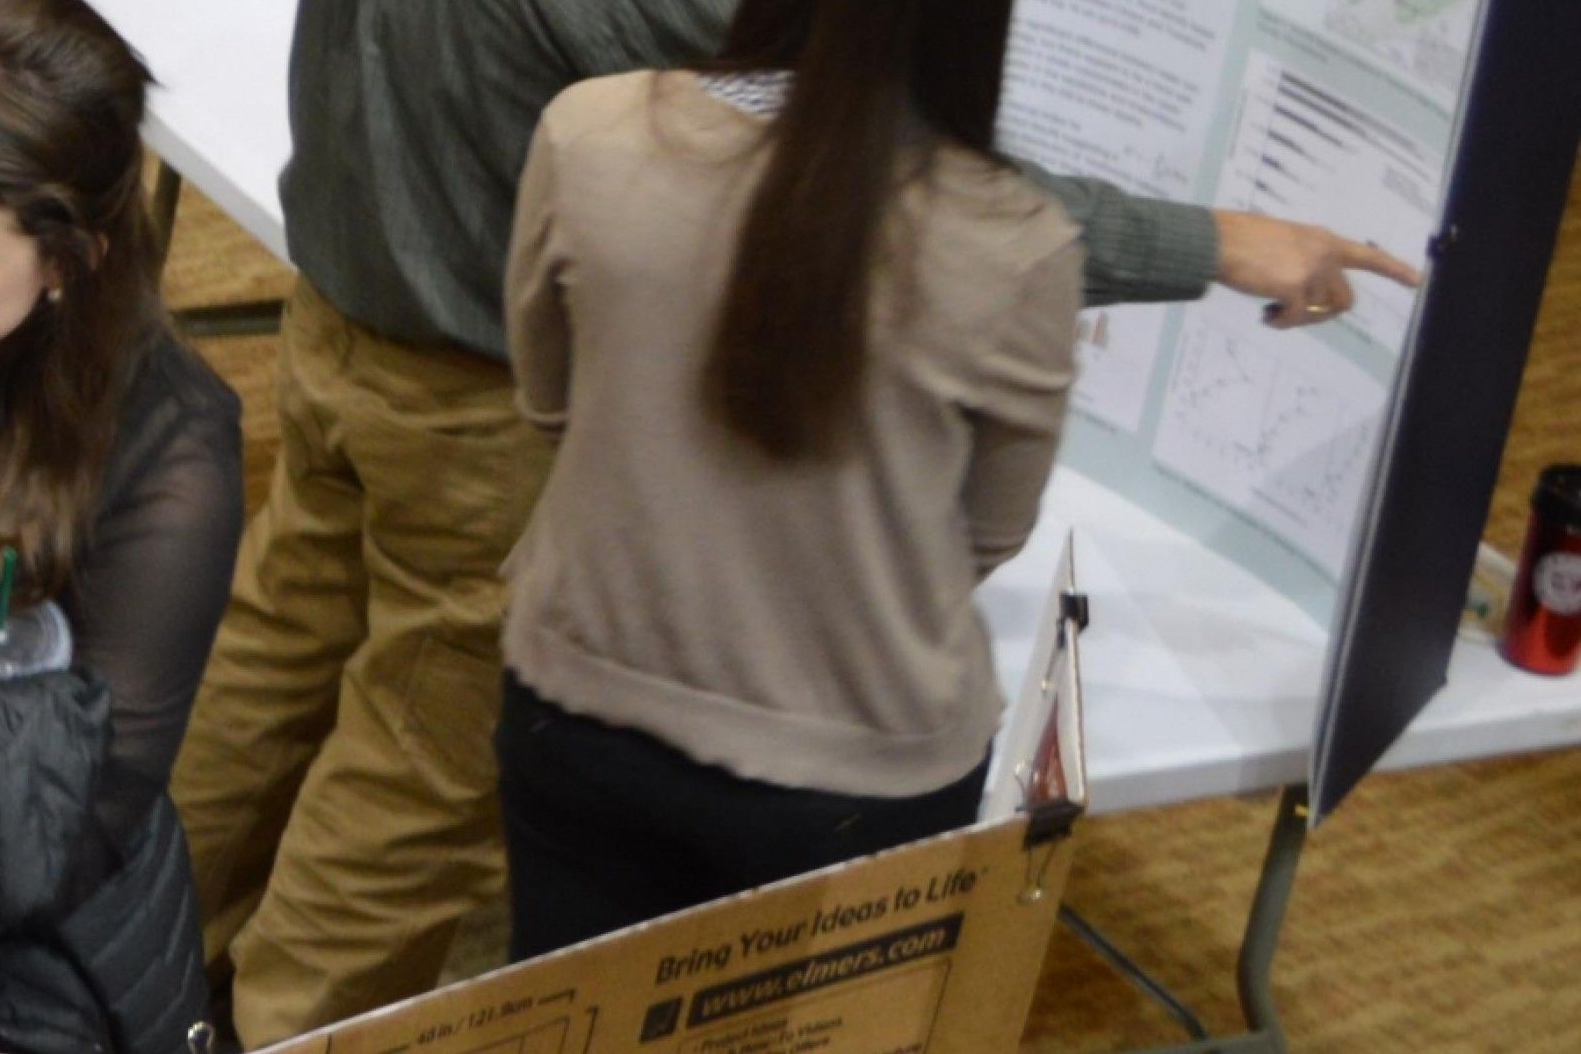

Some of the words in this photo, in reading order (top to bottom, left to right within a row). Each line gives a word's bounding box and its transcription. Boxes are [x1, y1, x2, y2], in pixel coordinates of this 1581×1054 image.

[655, 942, 734, 986] Bring
[739, 919, 807, 959] Your
[811, 895, 889, 938] Ideas
[893, 885, 922, 913] to
[700, 925, 948, 1019] www.elmers.com
